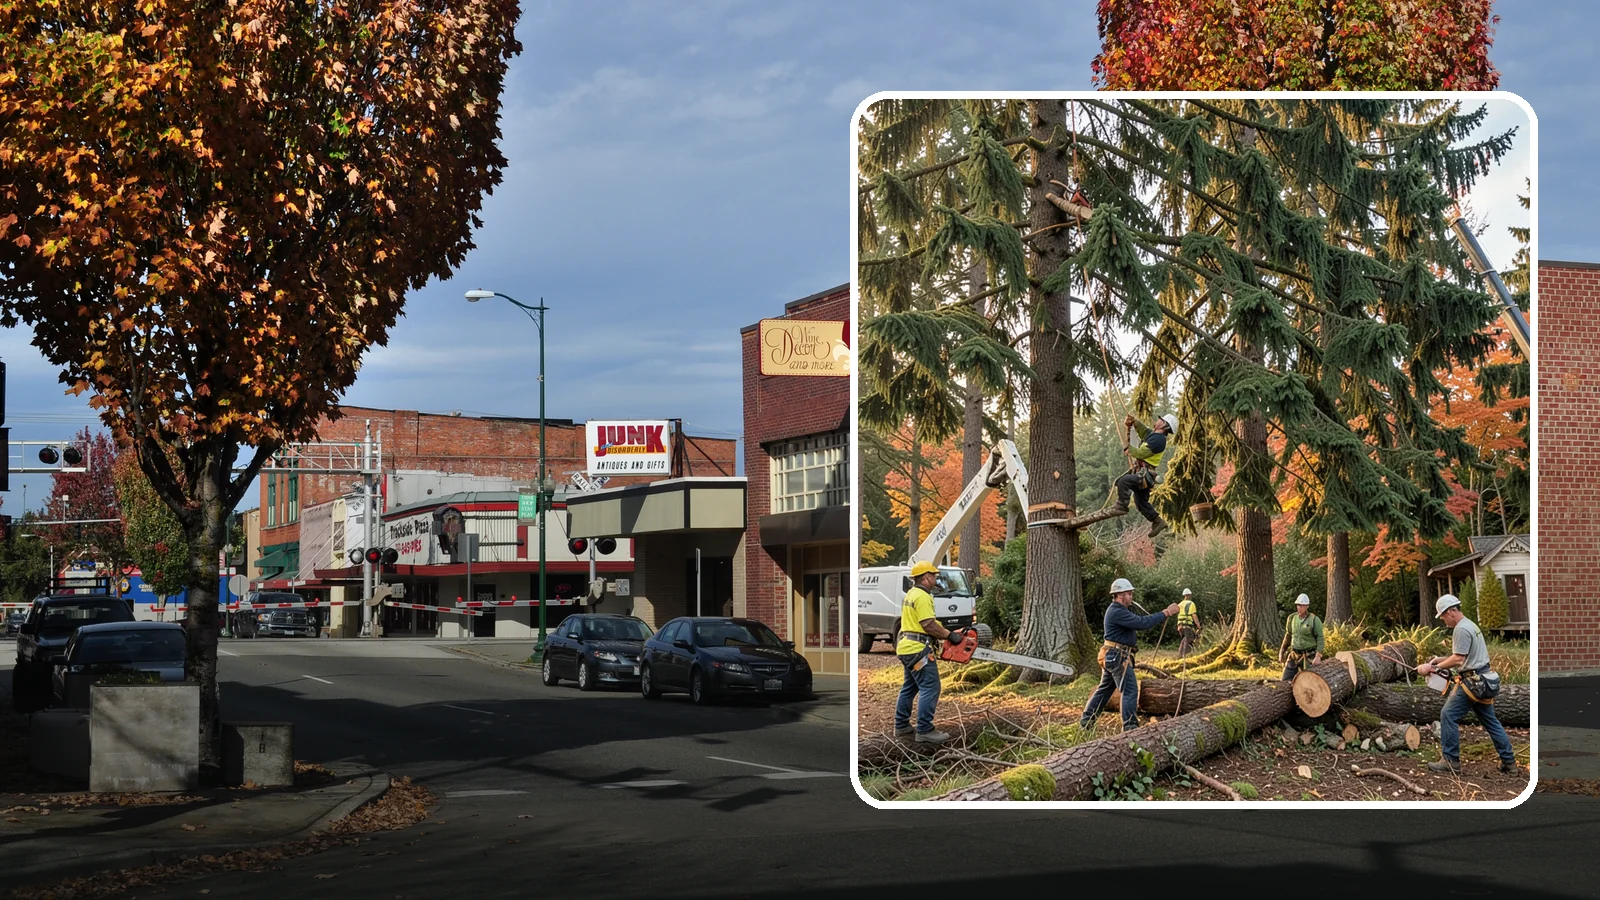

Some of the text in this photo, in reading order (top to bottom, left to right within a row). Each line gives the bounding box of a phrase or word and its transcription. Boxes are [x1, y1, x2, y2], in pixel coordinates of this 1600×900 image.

[596, 425, 665, 457] JUNK
[608, 446, 646, 454] DISORDERLY
[597, 461, 665, 470] ANTIQUES AND GIFTS
